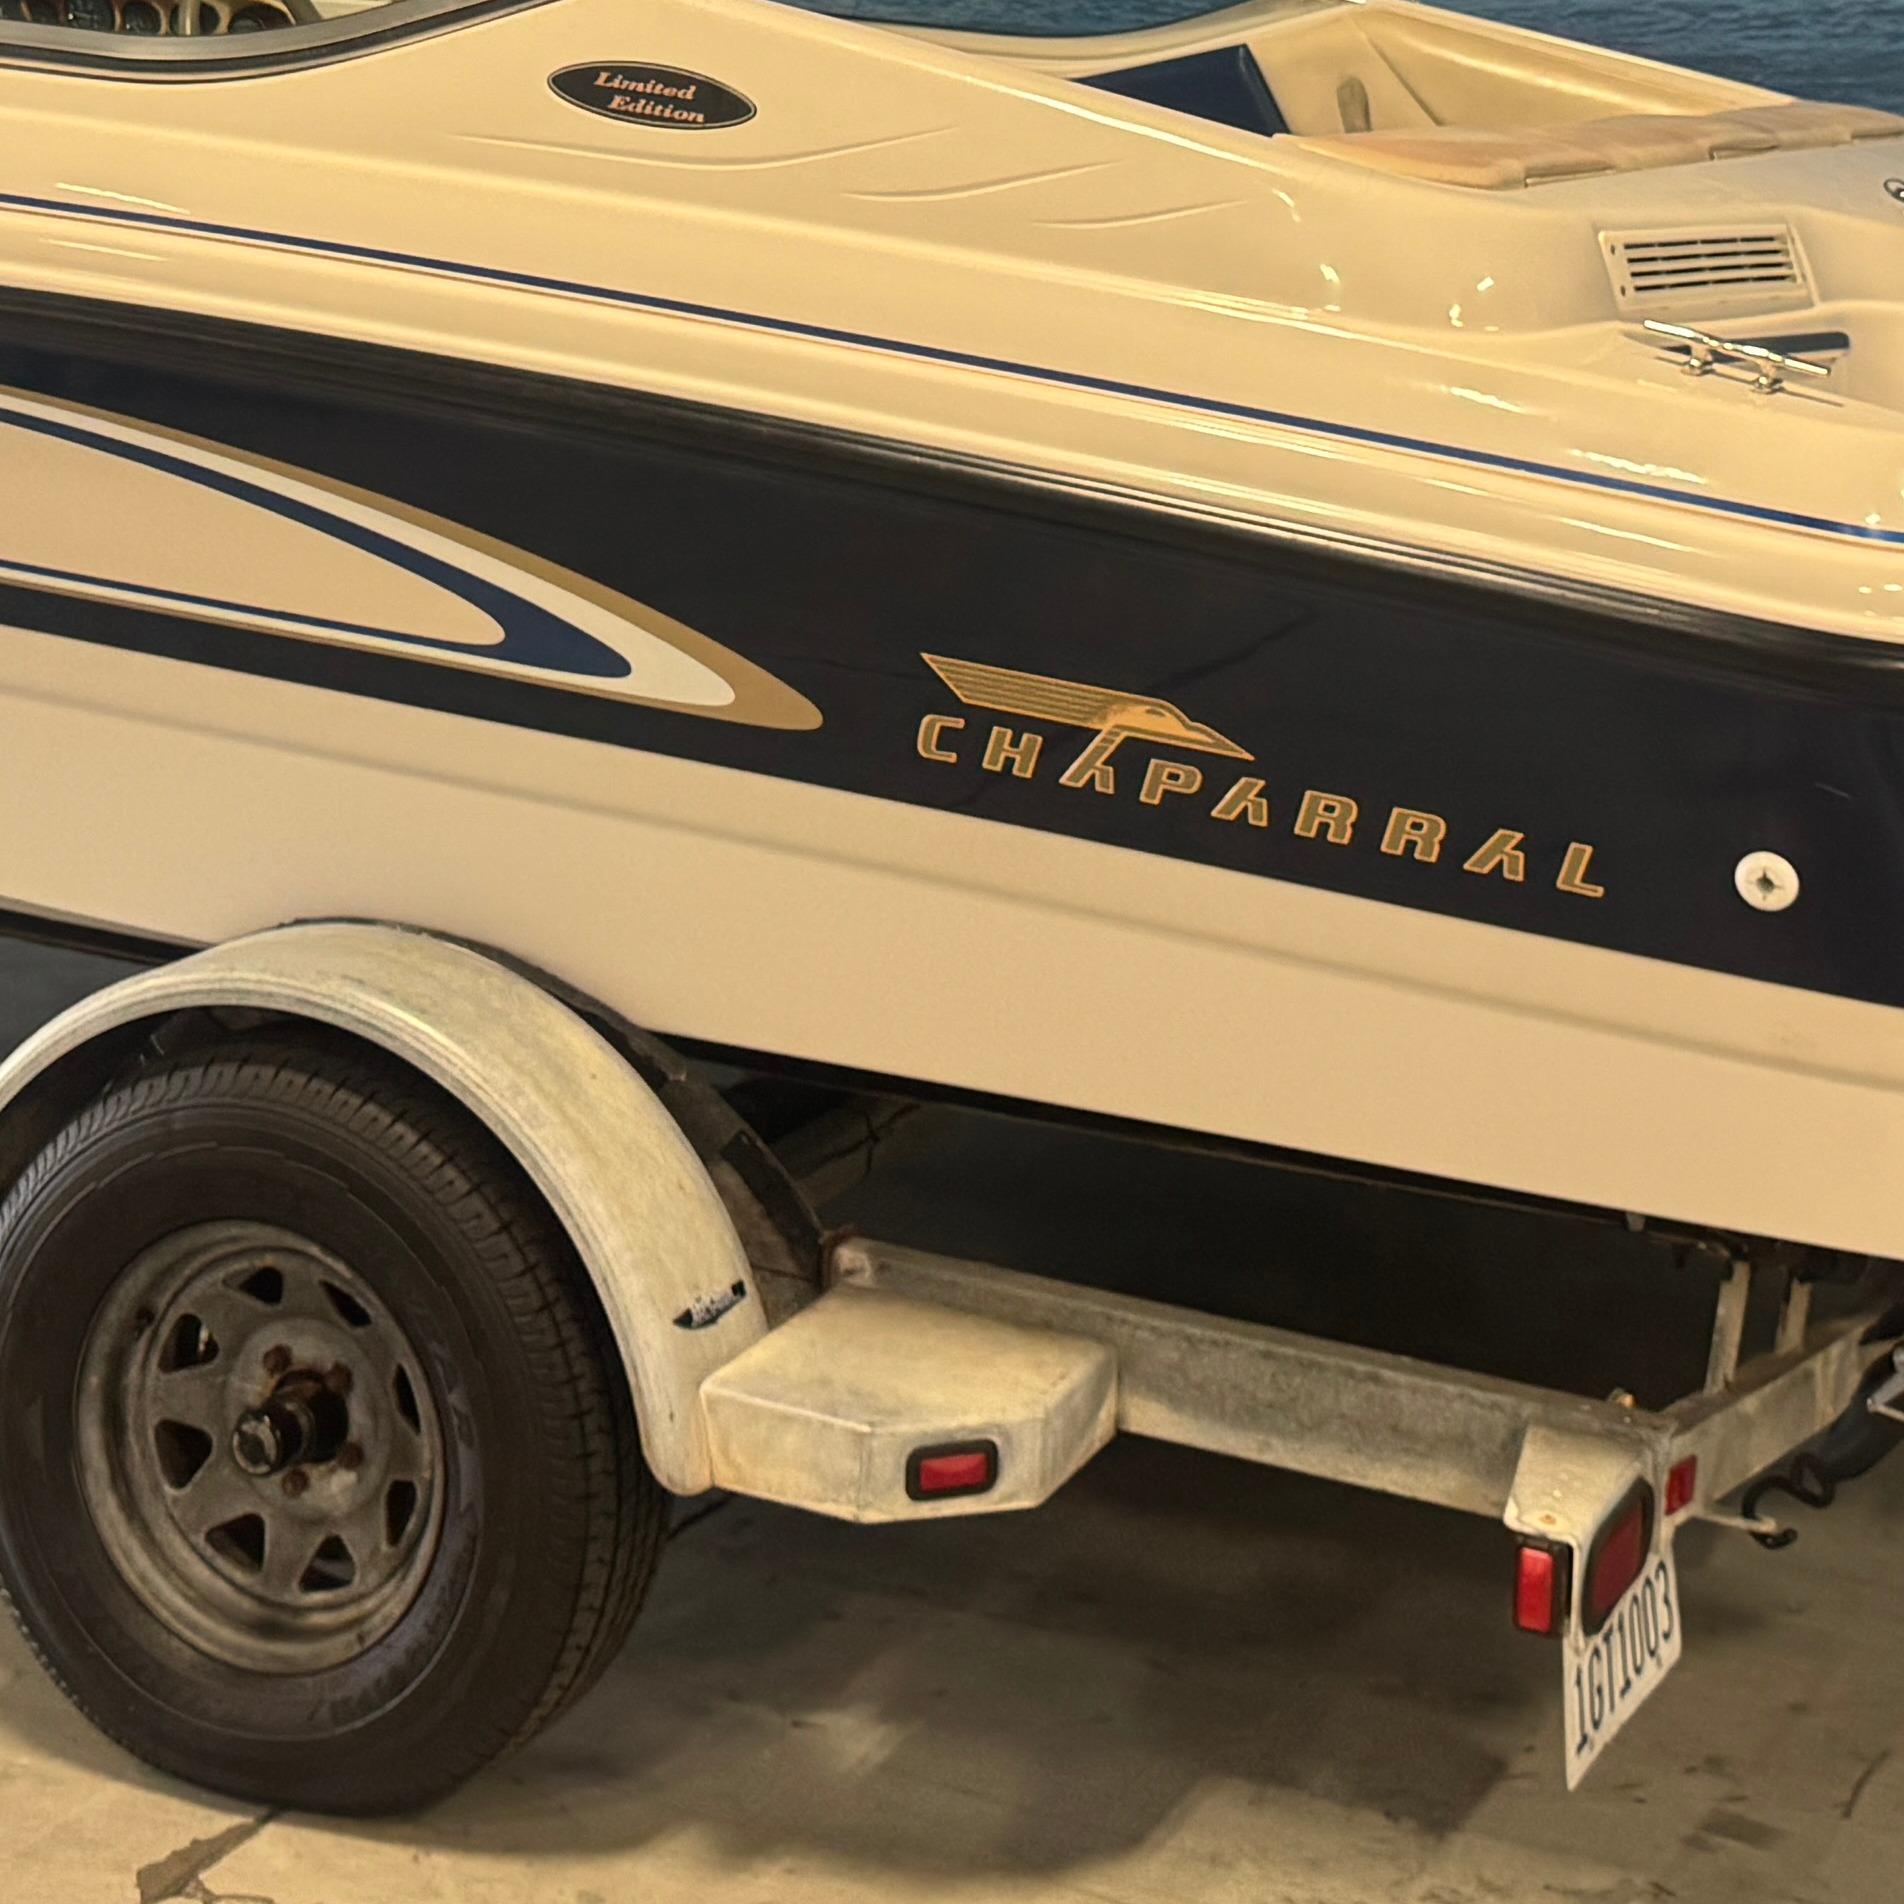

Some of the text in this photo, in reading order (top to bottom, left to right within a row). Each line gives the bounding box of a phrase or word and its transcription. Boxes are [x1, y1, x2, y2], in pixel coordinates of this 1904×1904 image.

[593, 71, 697, 100] Limited
[607, 95, 705, 124] Edition
[916, 713, 1605, 899] CHAPARRAL
